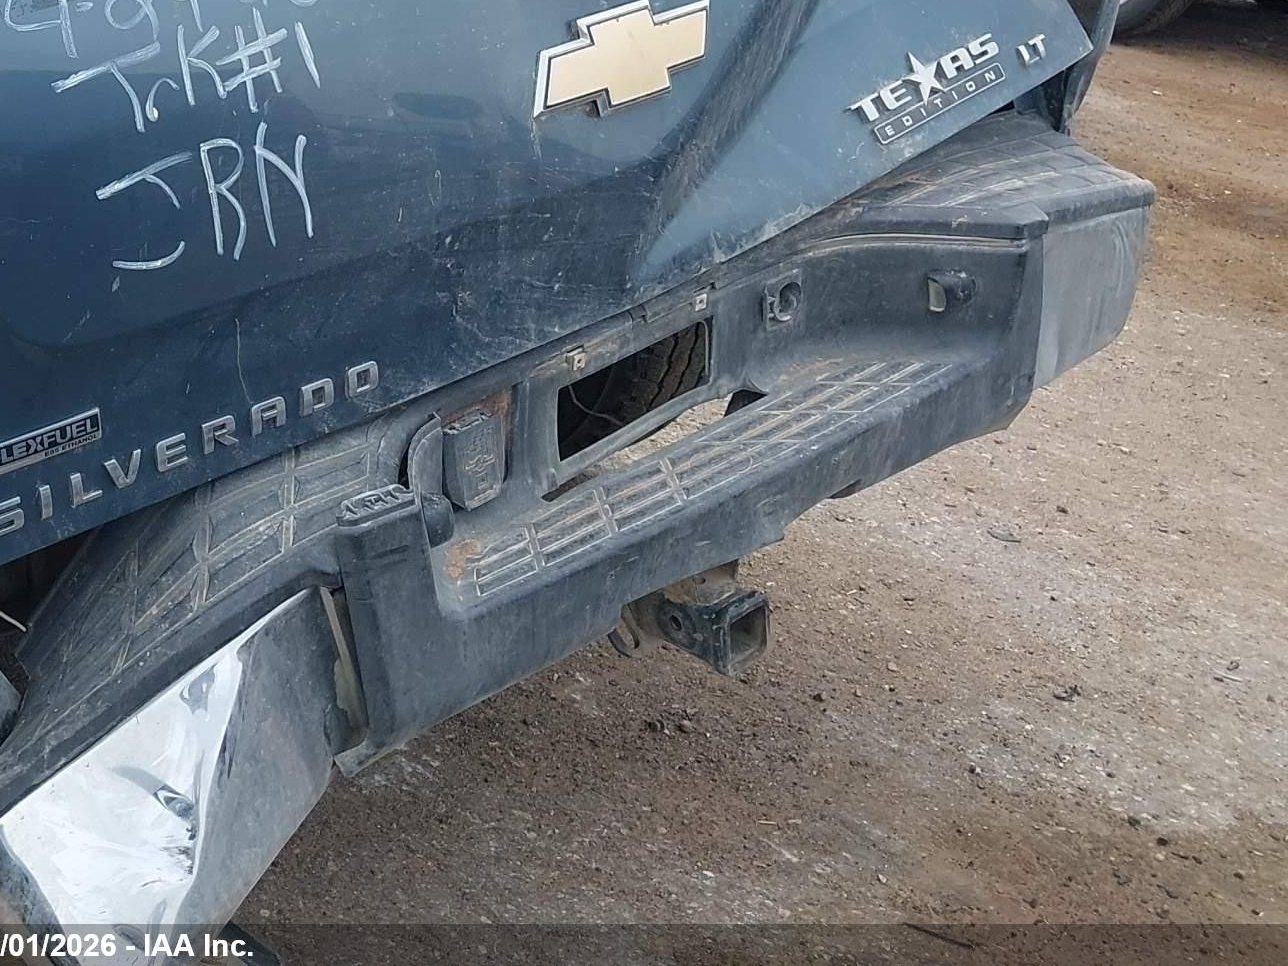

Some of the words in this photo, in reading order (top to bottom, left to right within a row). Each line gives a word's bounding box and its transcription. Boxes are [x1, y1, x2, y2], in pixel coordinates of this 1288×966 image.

[1016, 33, 1047, 66] LT
[845, 33, 1000, 122] TEXAS
[884, 69, 997, 137] EDITION
[61, 434, 99, 451] ETHANOL
